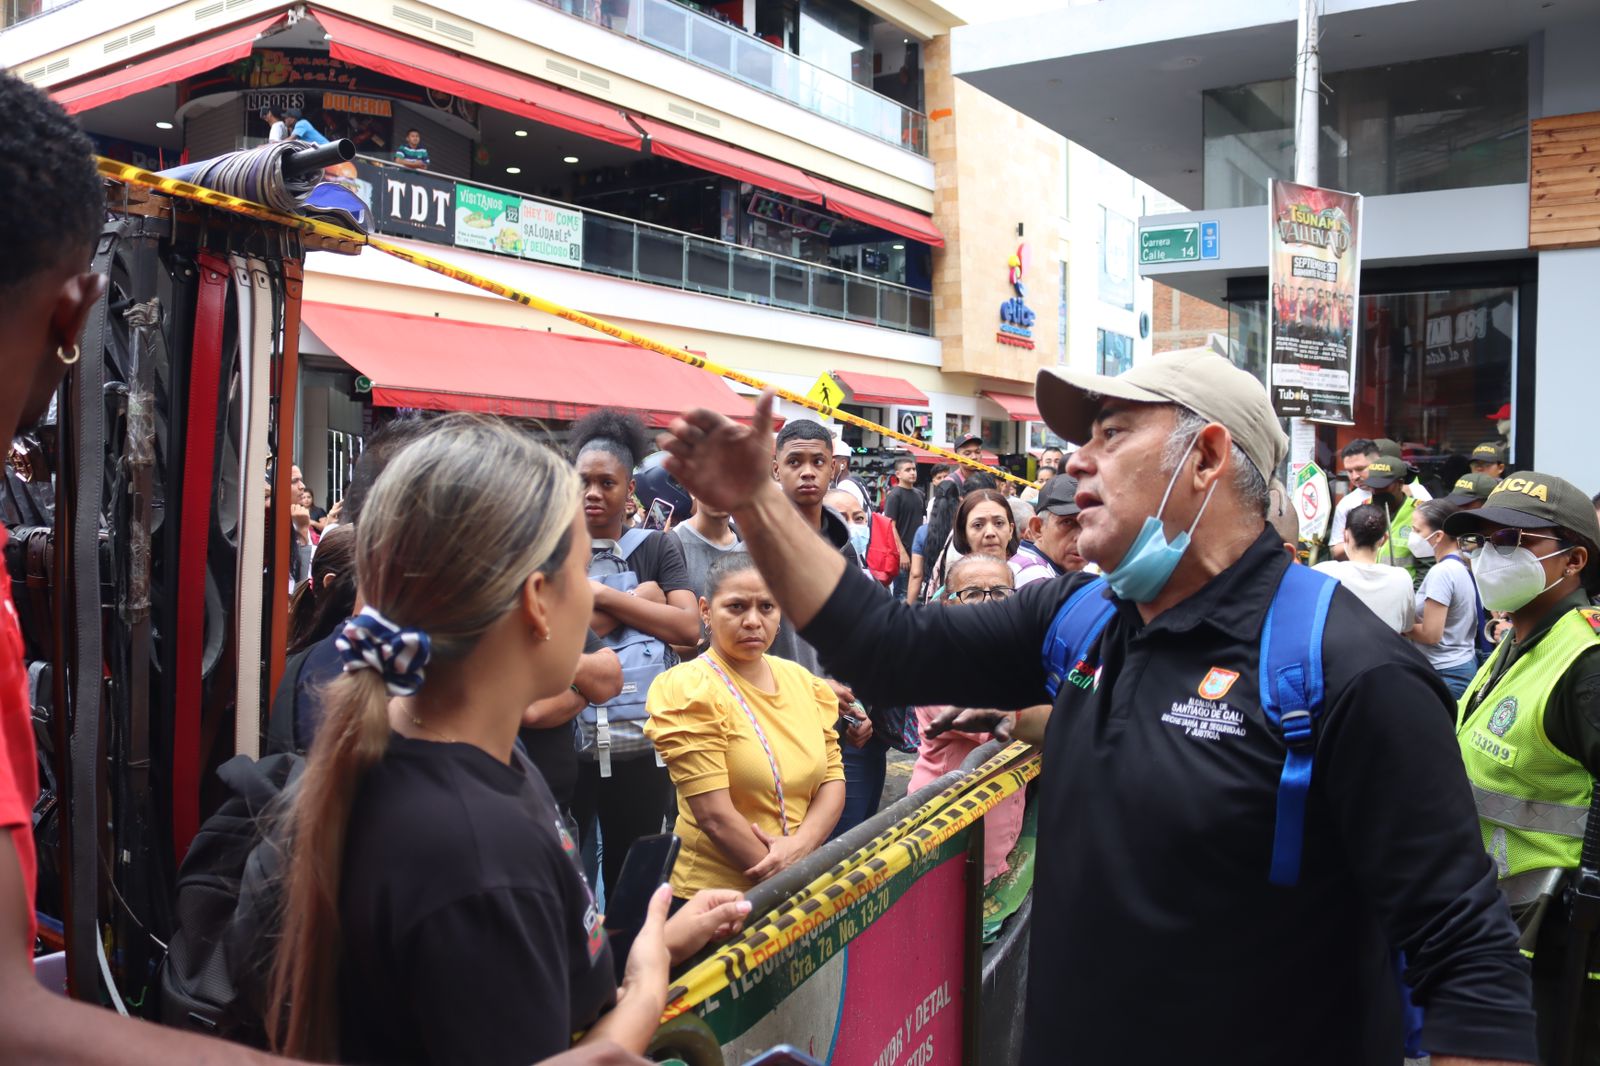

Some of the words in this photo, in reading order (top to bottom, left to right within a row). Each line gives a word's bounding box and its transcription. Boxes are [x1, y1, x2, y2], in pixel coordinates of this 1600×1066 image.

[247, 91, 305, 111] LICORES
[387, 178, 451, 228] TDT
[556, 211, 581, 231] COME
[1142, 232, 1171, 248] Carrera
[1183, 228, 1194, 243] 7
[1142, 248, 1166, 261] Calle
[1182, 246, 1194, 258] 14
[1171, 702, 1210, 718] SANTIAGO
[1210, 709, 1222, 719] DE
[1222, 710, 1244, 724] CALI
[1219, 702, 1229, 711] DE
[1191, 729, 1221, 741] JUSTICIA
[1200, 721, 1208, 730] DE
[1208, 722, 1246, 737] SEGURIDAD
[789, 955, 816, 987] Cra.
[818, 936, 833, 962] 7a
[838, 919, 858, 947] No.
[860, 887, 890, 928] 13-70
[905, 1013, 913, 1044] Y
[915, 980, 952, 1034] DETAL
